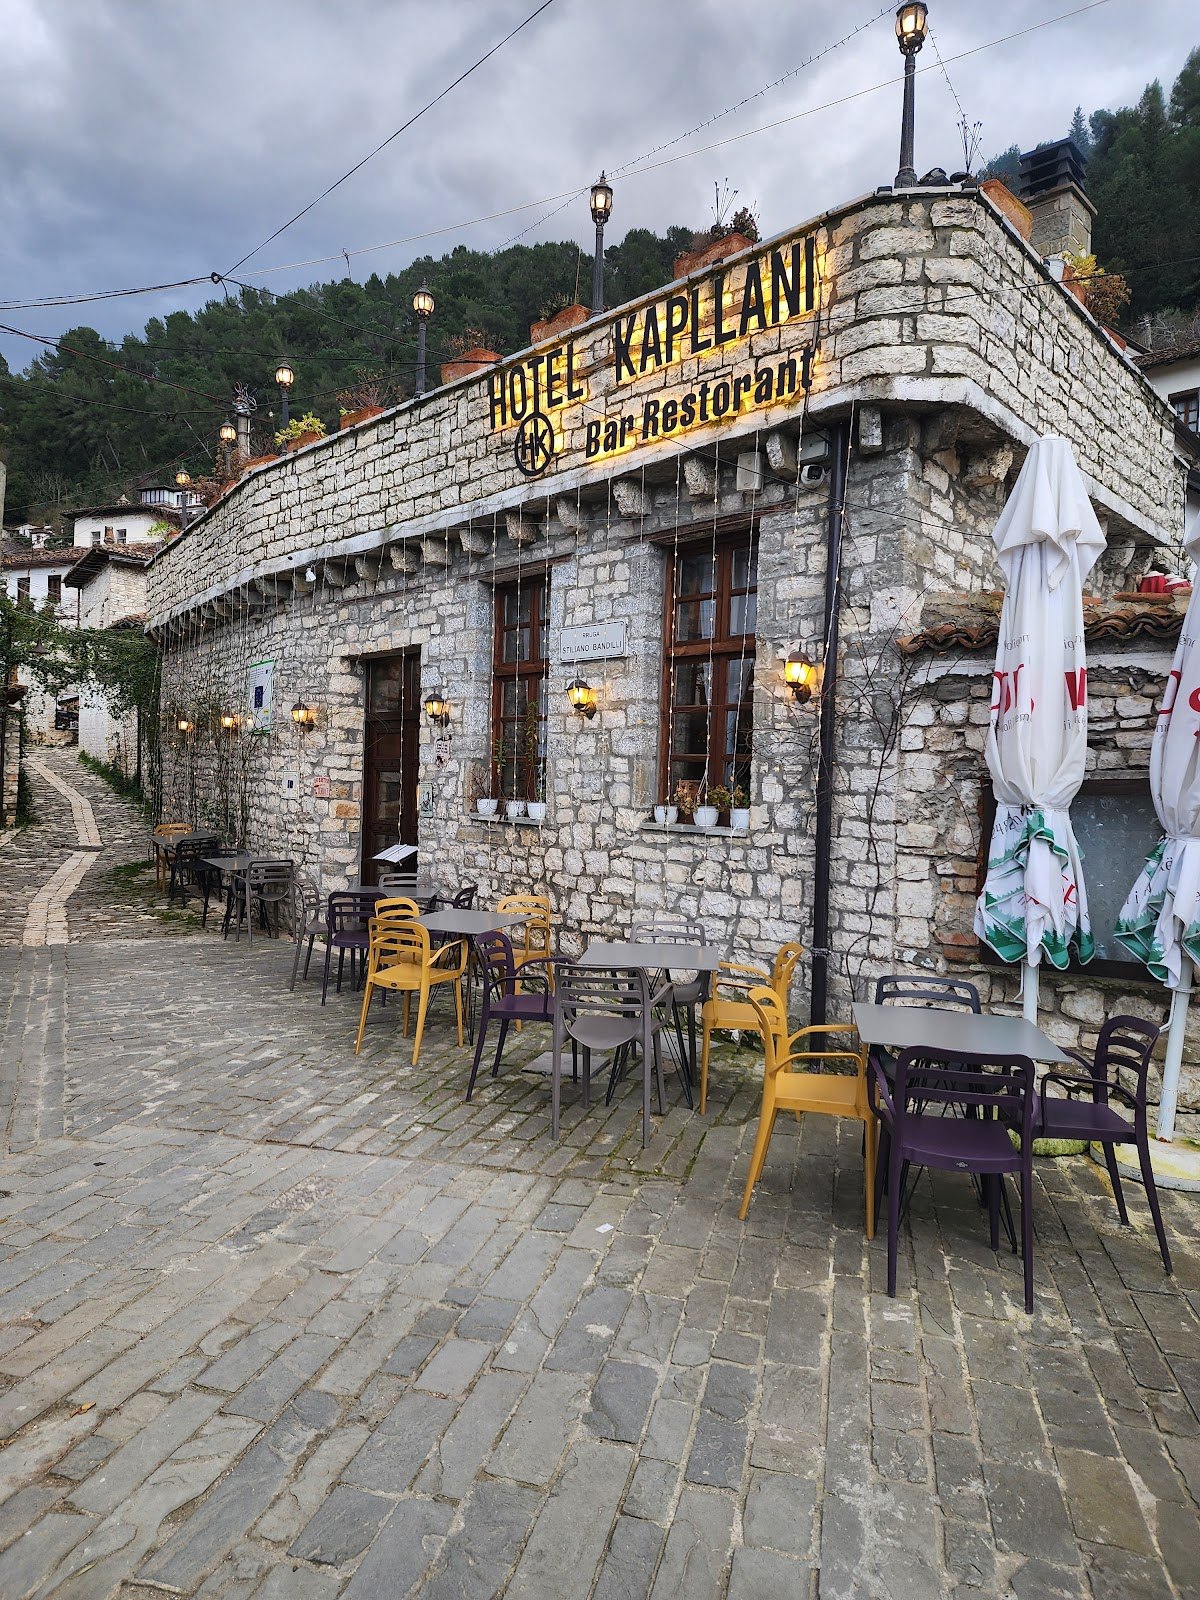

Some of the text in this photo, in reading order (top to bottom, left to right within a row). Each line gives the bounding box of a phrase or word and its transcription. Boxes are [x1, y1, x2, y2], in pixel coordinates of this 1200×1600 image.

[488, 236, 817, 430] HOTEL KAPLLANI
[586, 349, 817, 459] Bar Restorant
[562, 640, 622, 654] STILIANO BANDILLI
